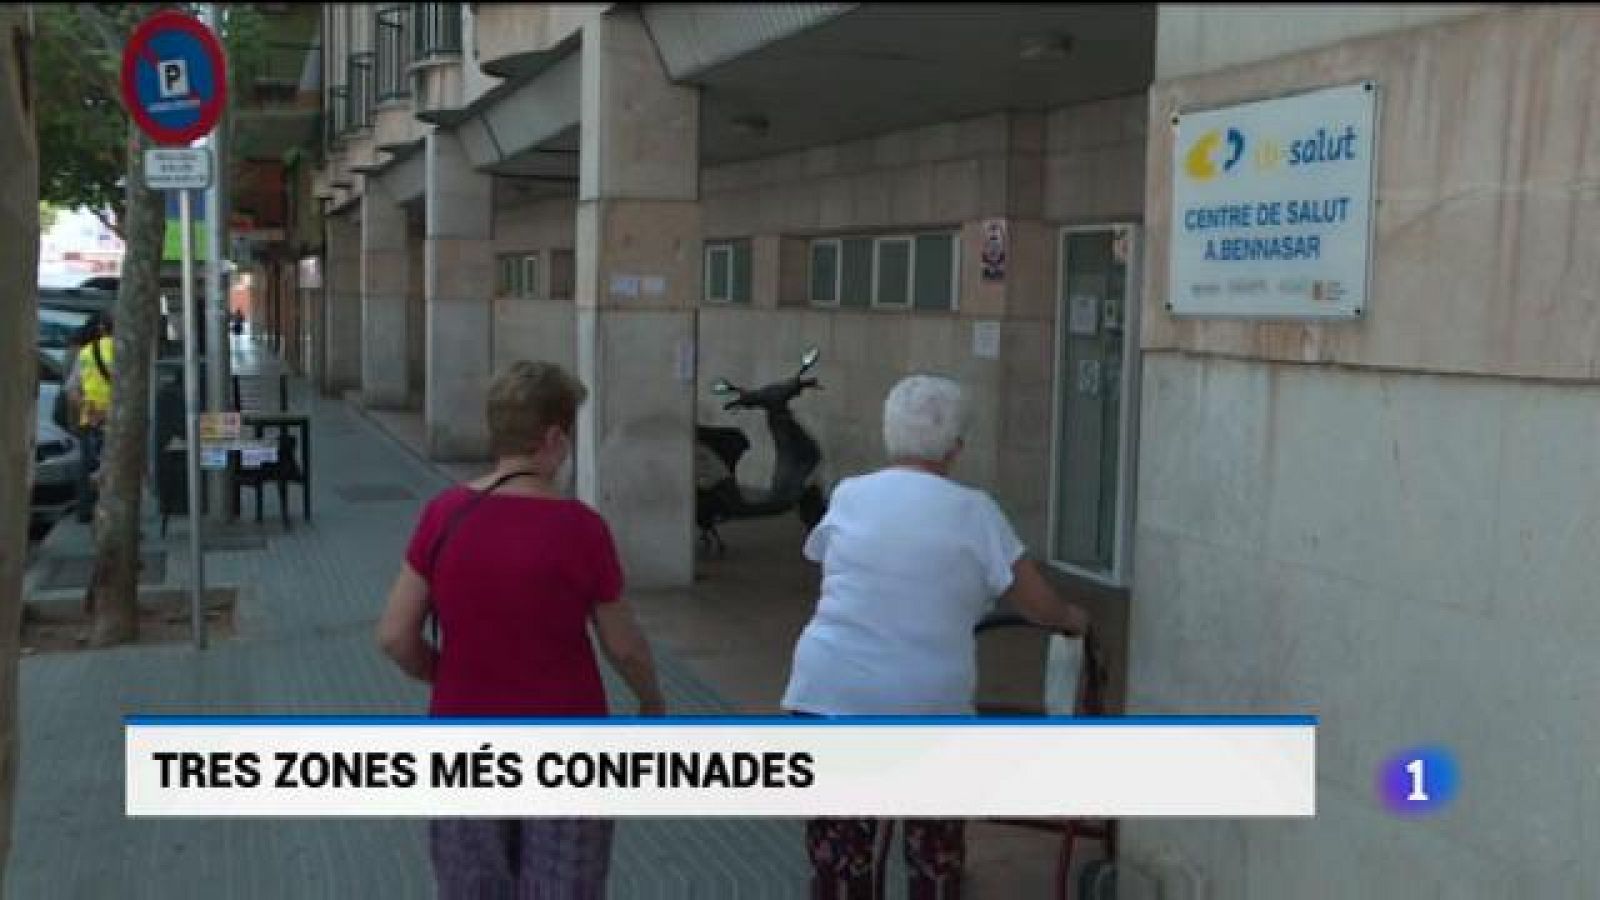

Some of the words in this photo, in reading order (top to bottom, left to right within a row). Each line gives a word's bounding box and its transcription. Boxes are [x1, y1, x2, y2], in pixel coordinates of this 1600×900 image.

[164, 64, 181, 90] P
[1184, 204, 1250, 231] CENTRE
[1256, 202, 1281, 226] DE
[1287, 197, 1350, 225] SALUT
